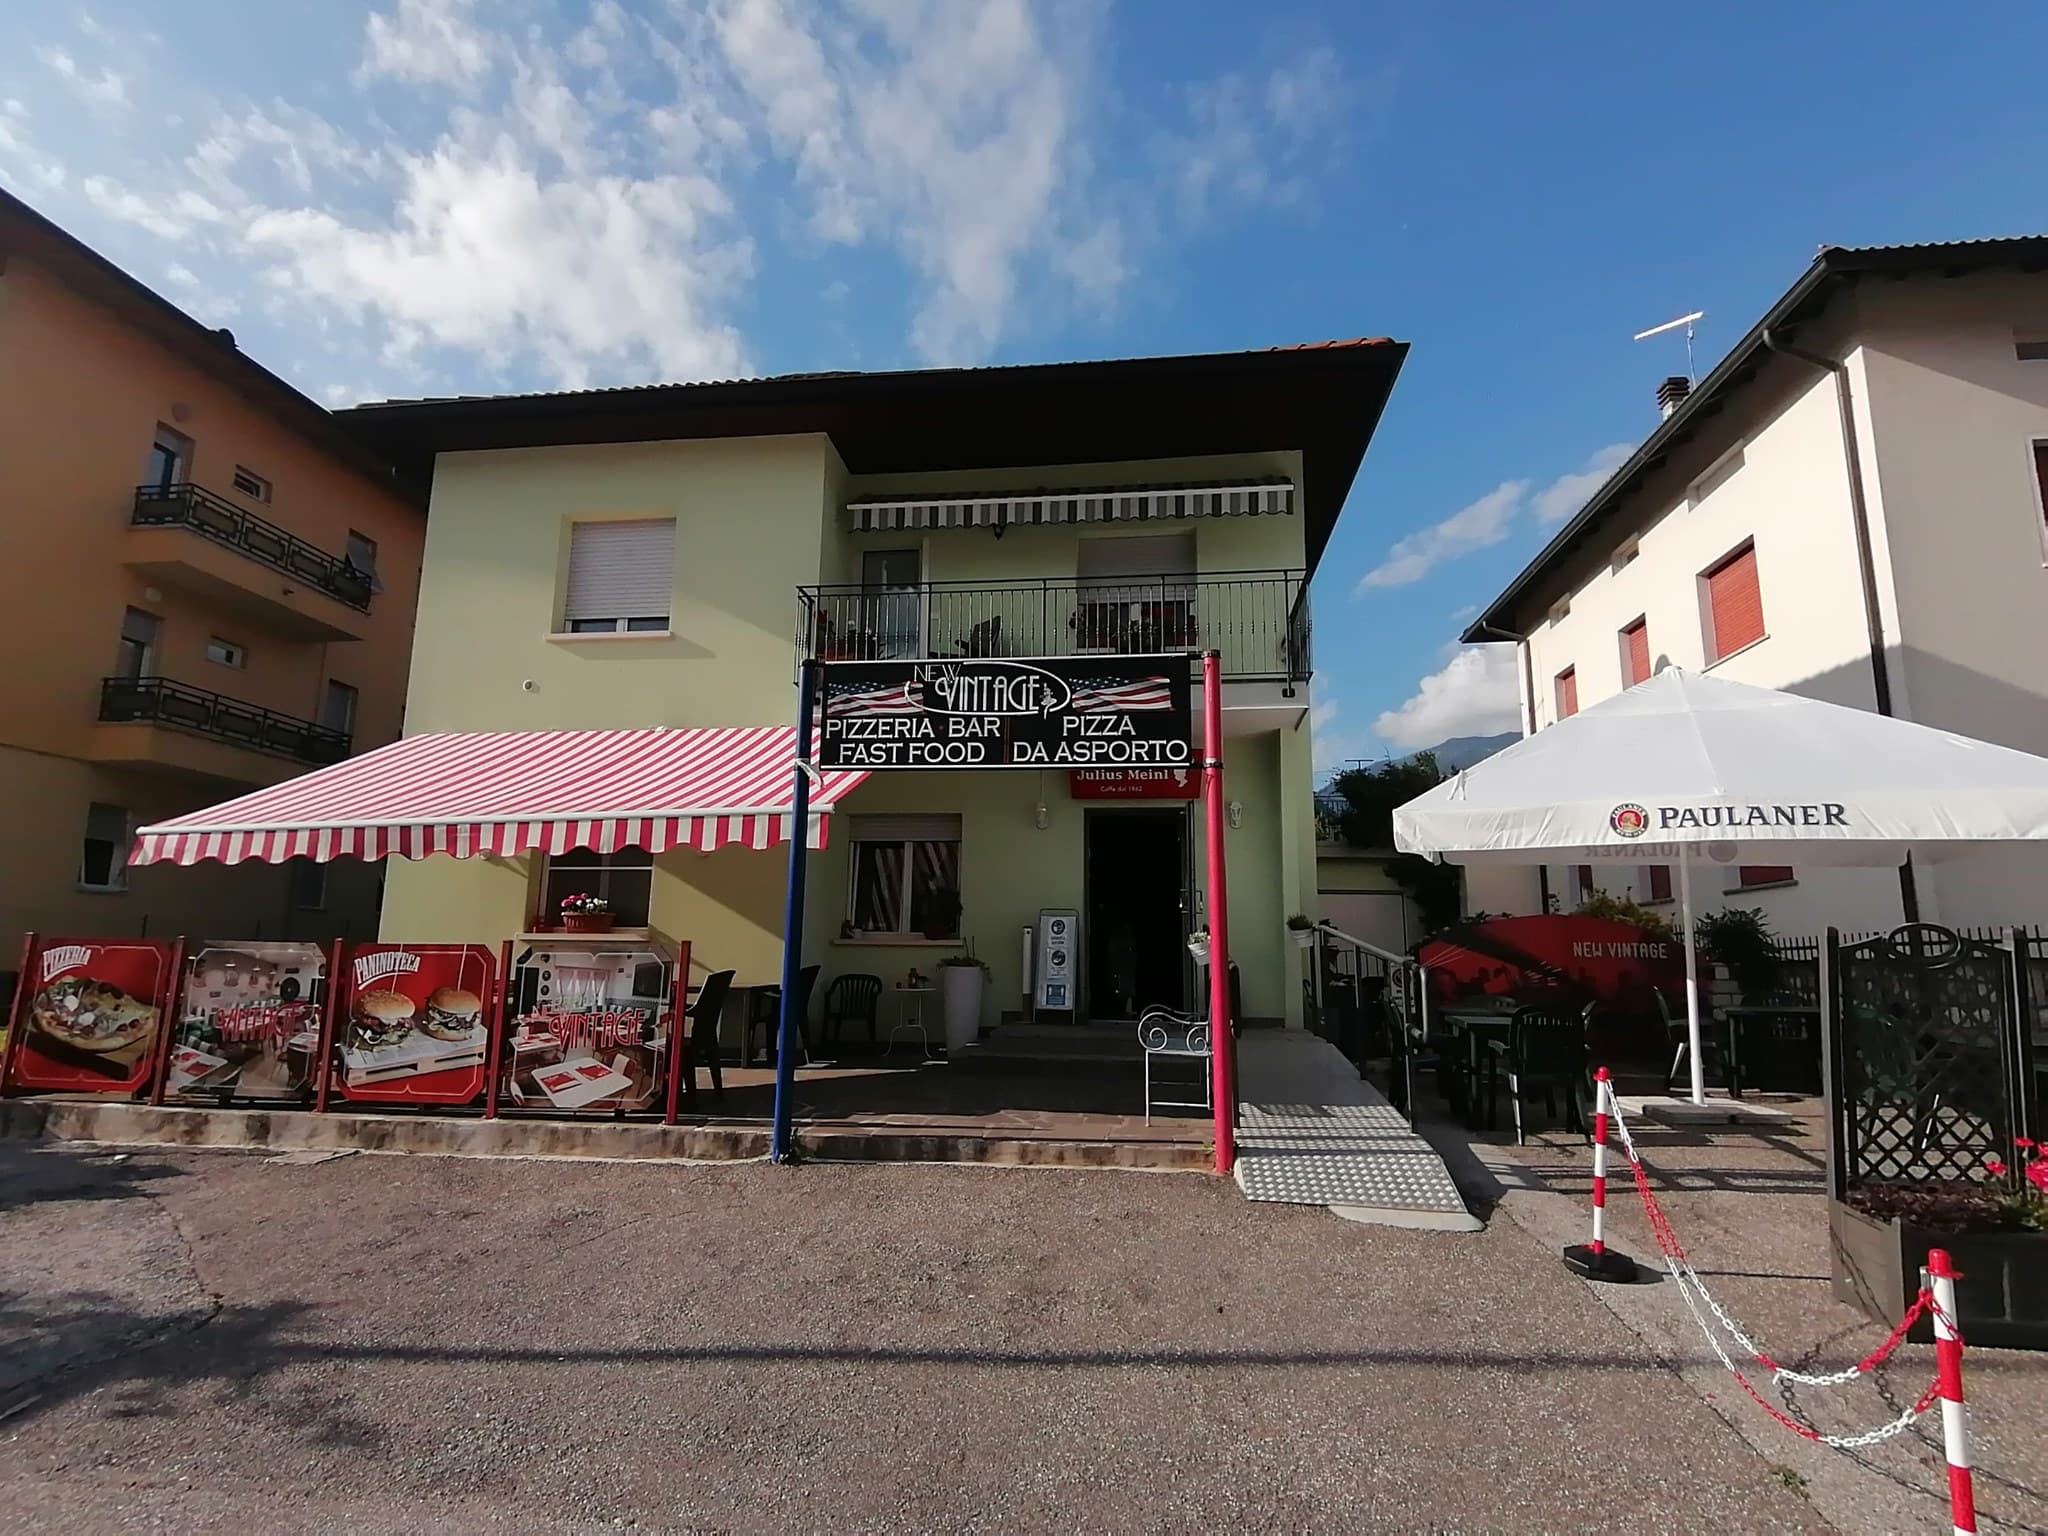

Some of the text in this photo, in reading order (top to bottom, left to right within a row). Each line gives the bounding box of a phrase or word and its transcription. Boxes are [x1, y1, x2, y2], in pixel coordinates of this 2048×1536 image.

[914, 664, 961, 683] NEW
[935, 675, 1040, 711] VINTAGE
[826, 716, 1001, 739] PIZZERIA BAR
[1063, 715, 1137, 736] PIZZA
[839, 742, 985, 763] FAST FOOD
[1013, 740, 1188, 762] DA ASPORTO
[1077, 768, 1169, 781] Julius Meinl
[1658, 803, 1850, 829] PAULANER
[1573, 942, 1669, 959] NEW VINTAGE
[354, 951, 421, 985] PANINOTECA
[549, 1007, 645, 1048] VINTAGE
